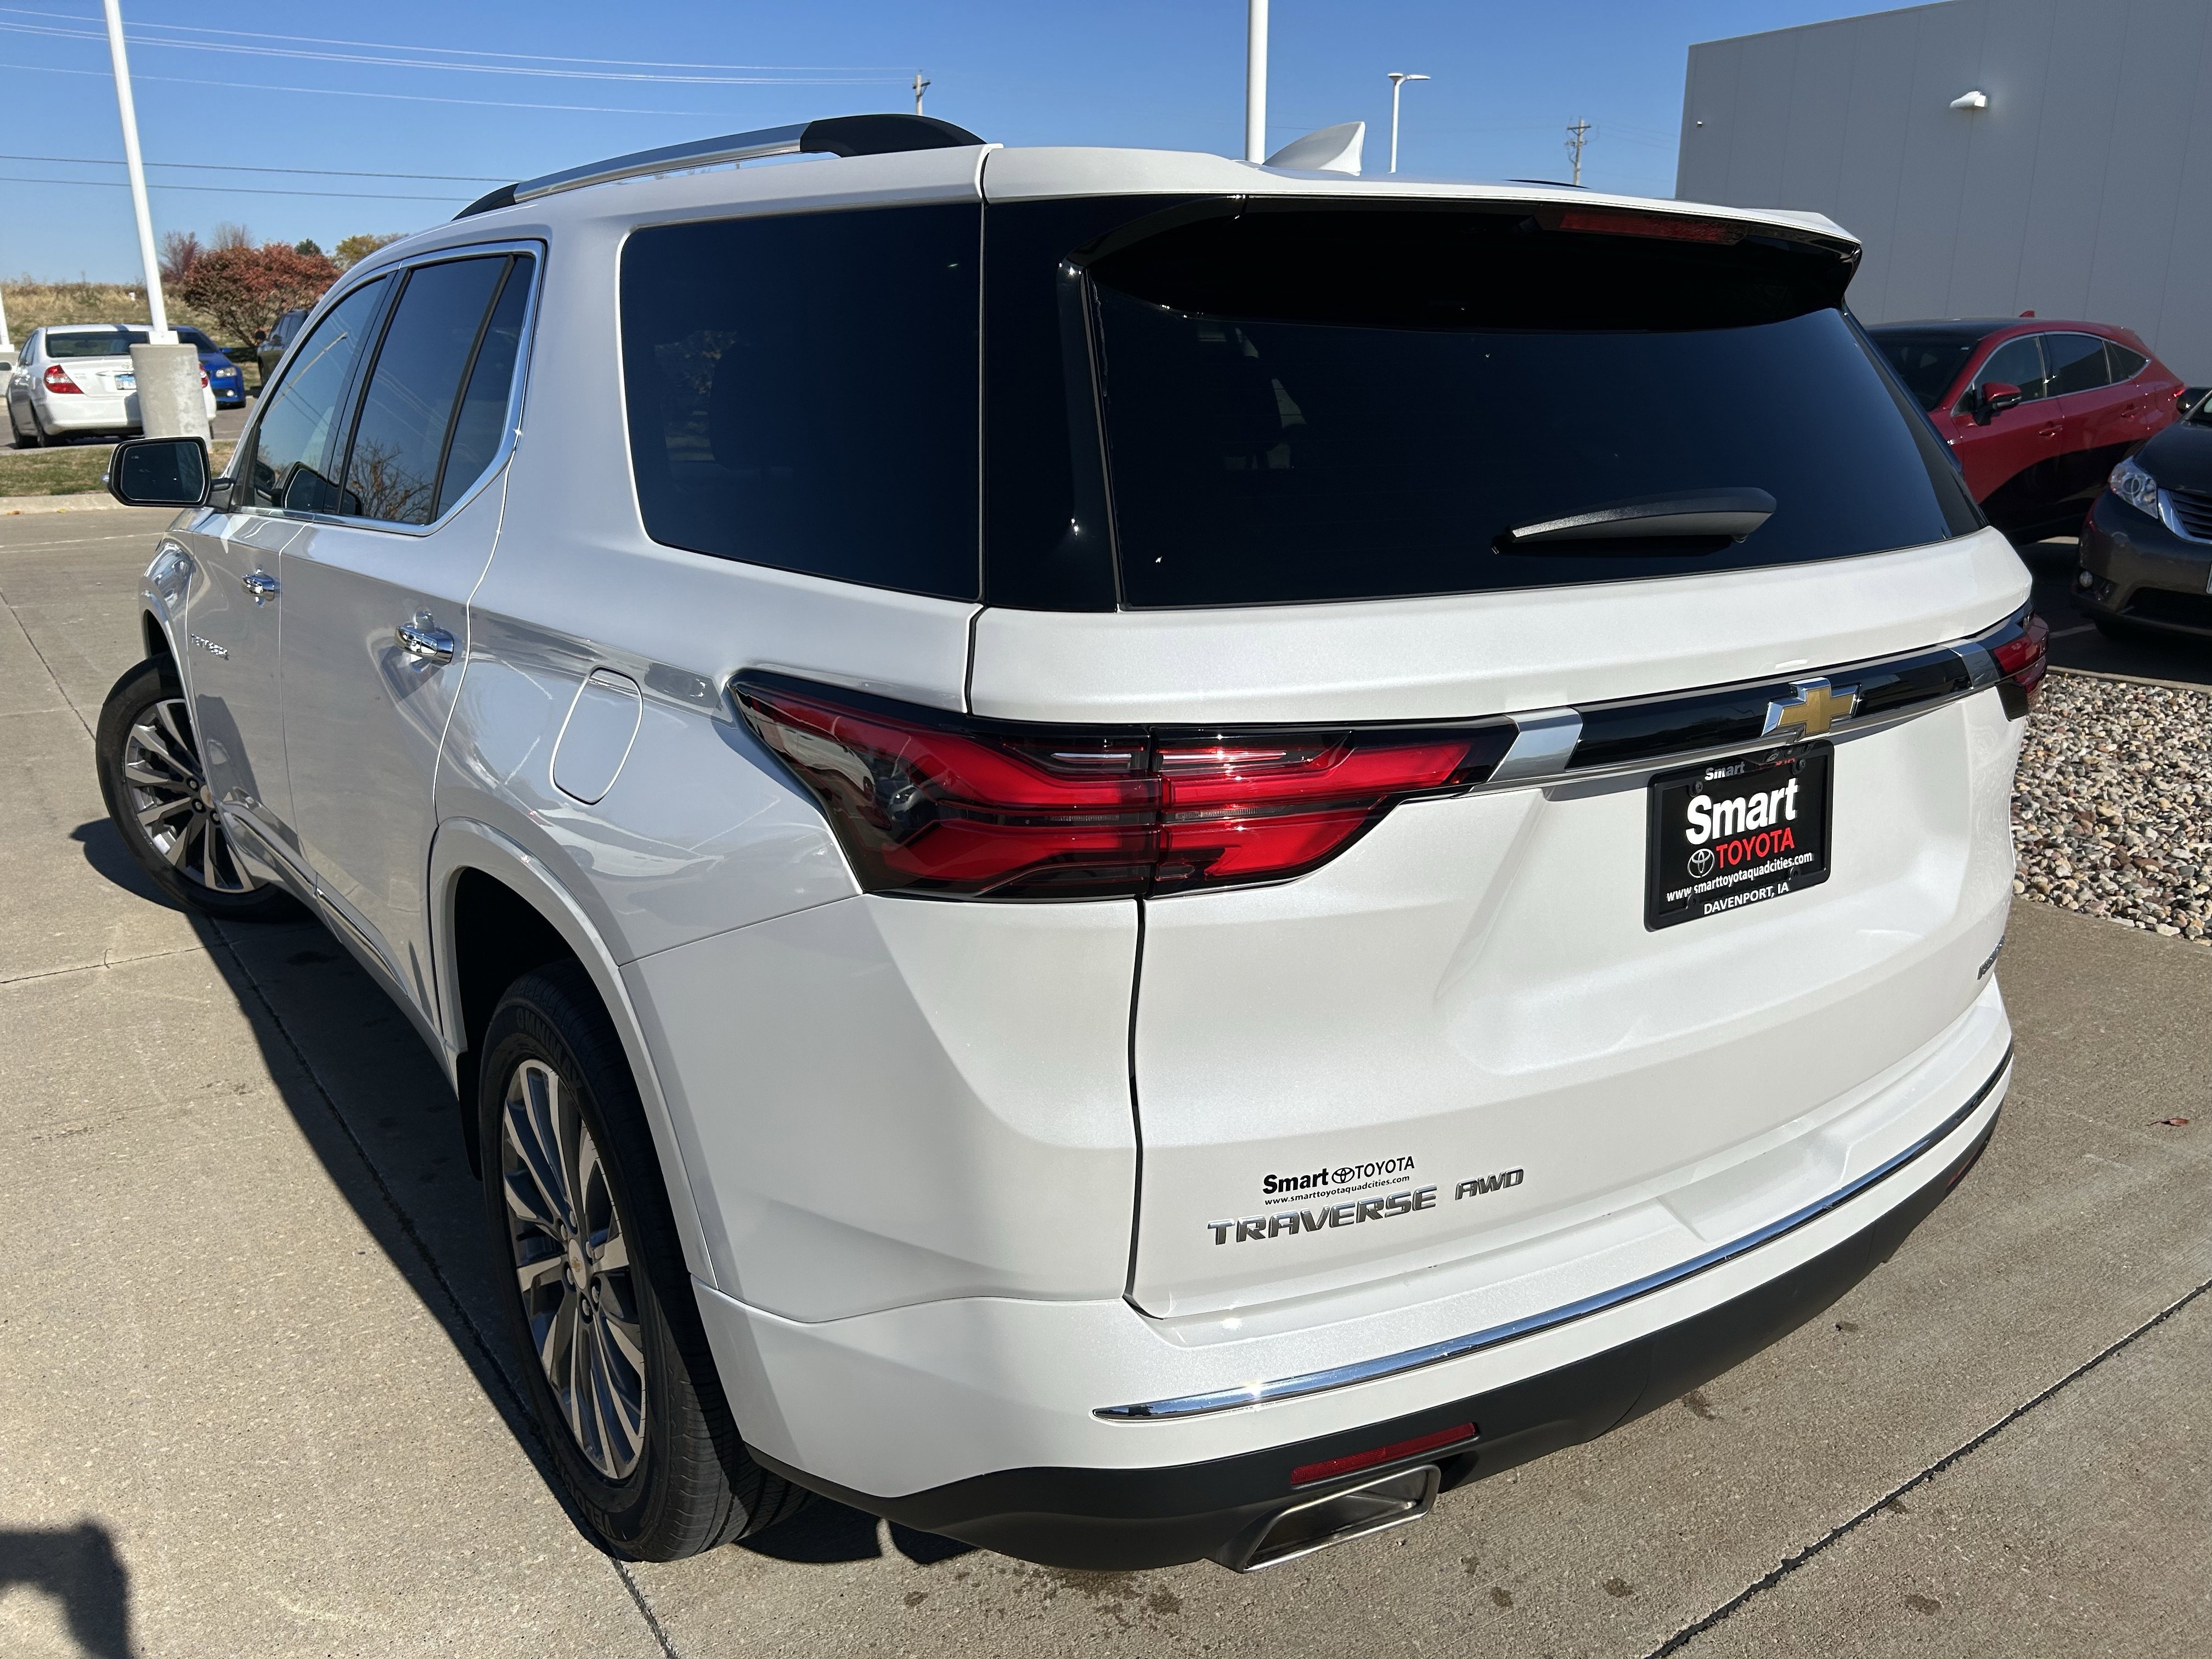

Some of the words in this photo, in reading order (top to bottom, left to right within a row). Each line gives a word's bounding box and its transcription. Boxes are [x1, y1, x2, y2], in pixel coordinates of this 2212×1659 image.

[1705, 761, 1745, 781] Smart
[1685, 777, 1798, 845] Smart
[1716, 827, 1795, 868] TOYOTA
[1666, 852, 1813, 902] wwwsmarttoyotaquadcities.com
[1704, 885, 1775, 915] DAVENPORT,
[1778, 882, 1790, 895] IA
[1262, 1167, 1329, 1194] Smart
[1355, 1155, 1415, 1179] TOYOTA
[1265, 1175, 1410, 1205] www.smarttoyotaquadcities.com
[1207, 1184, 1437, 1245] TRAVERSE
[1454, 1166, 1524, 1200] AWD
